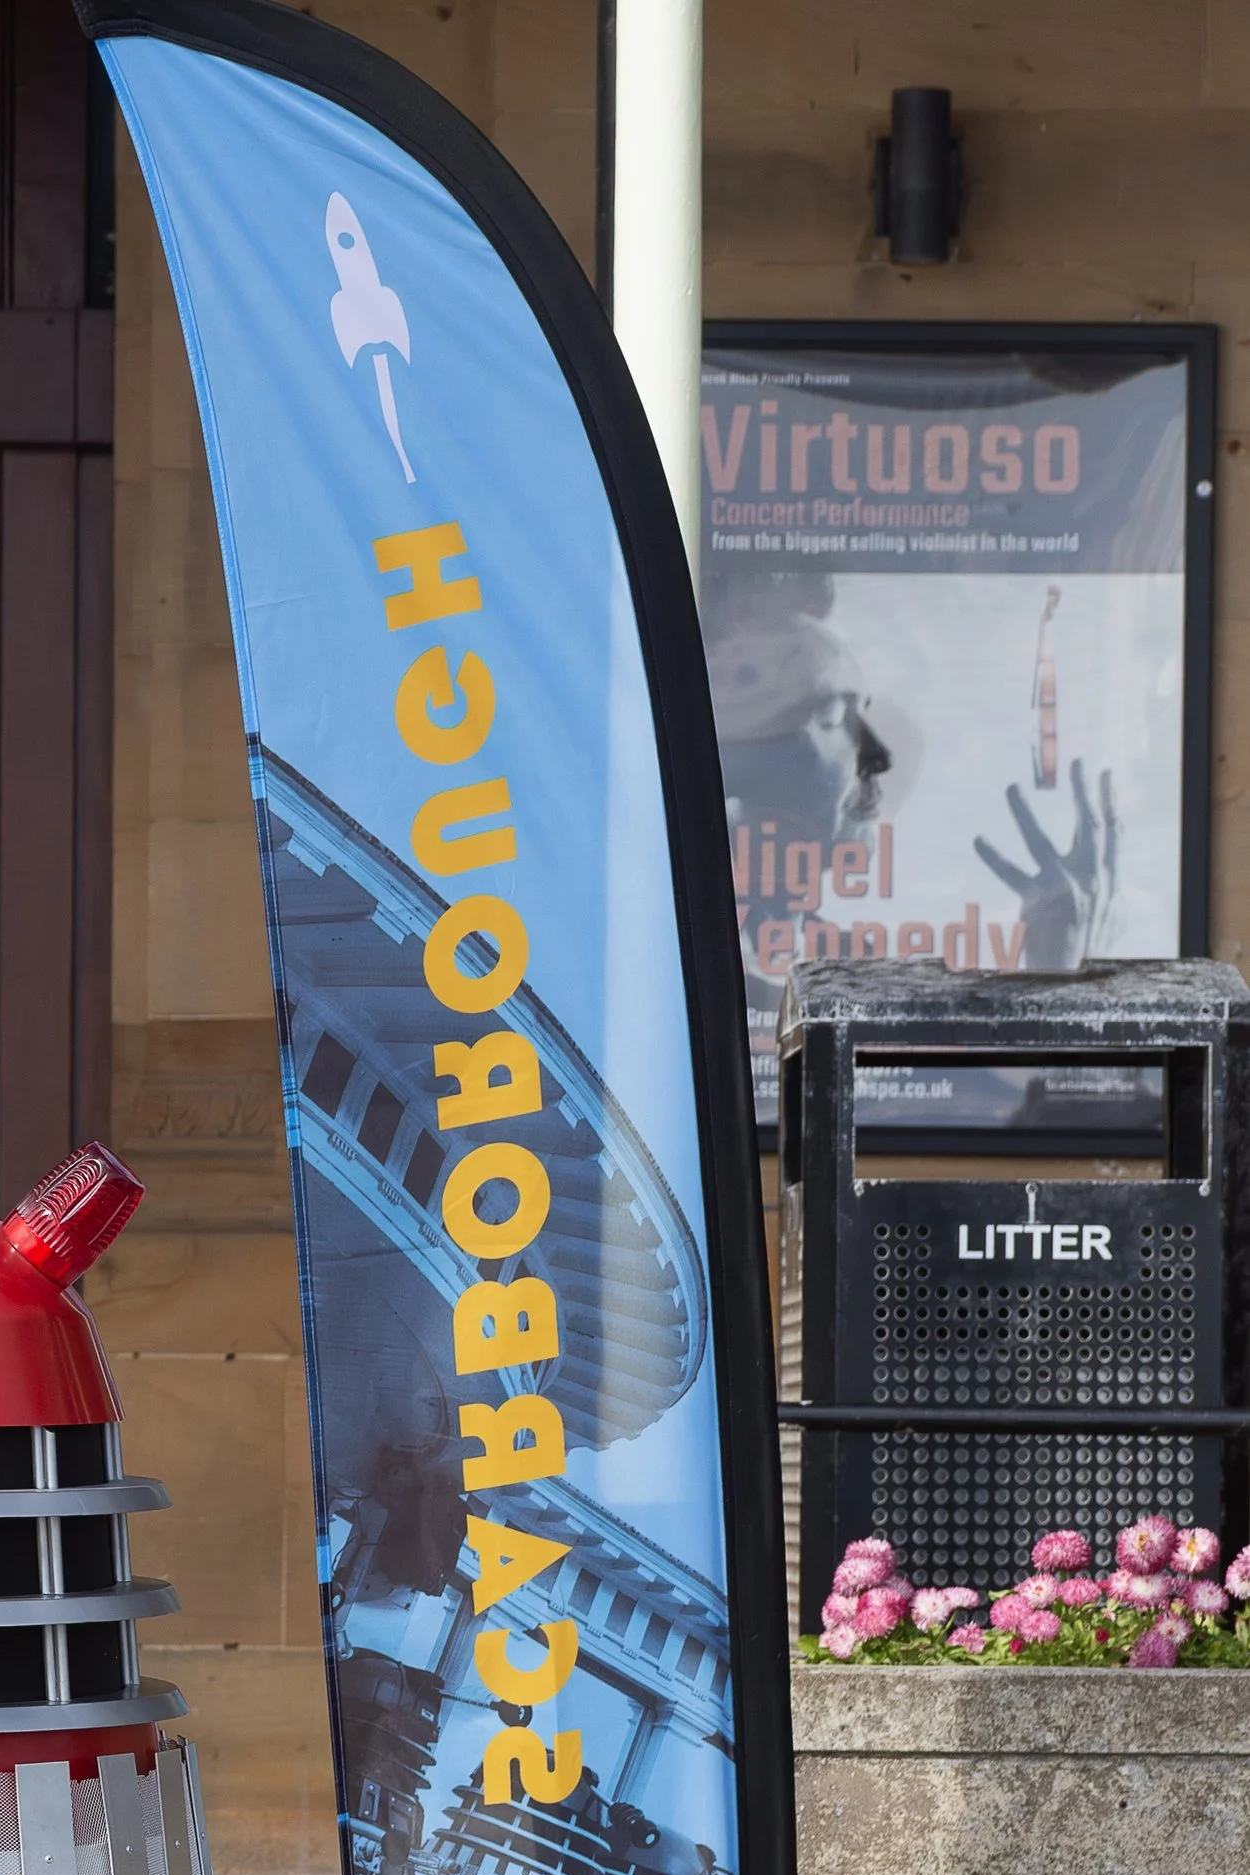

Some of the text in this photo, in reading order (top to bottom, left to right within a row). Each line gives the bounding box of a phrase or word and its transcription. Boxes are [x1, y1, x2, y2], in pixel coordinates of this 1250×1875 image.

[701, 400, 1081, 494] Virtuoso
[711, 496, 970, 527] Concert Performance
[712, 531, 1080, 555] from the biggest selling violinist in the world
[737, 903, 1028, 976] ennedy
[957, 1223, 1114, 1261] LITTER
